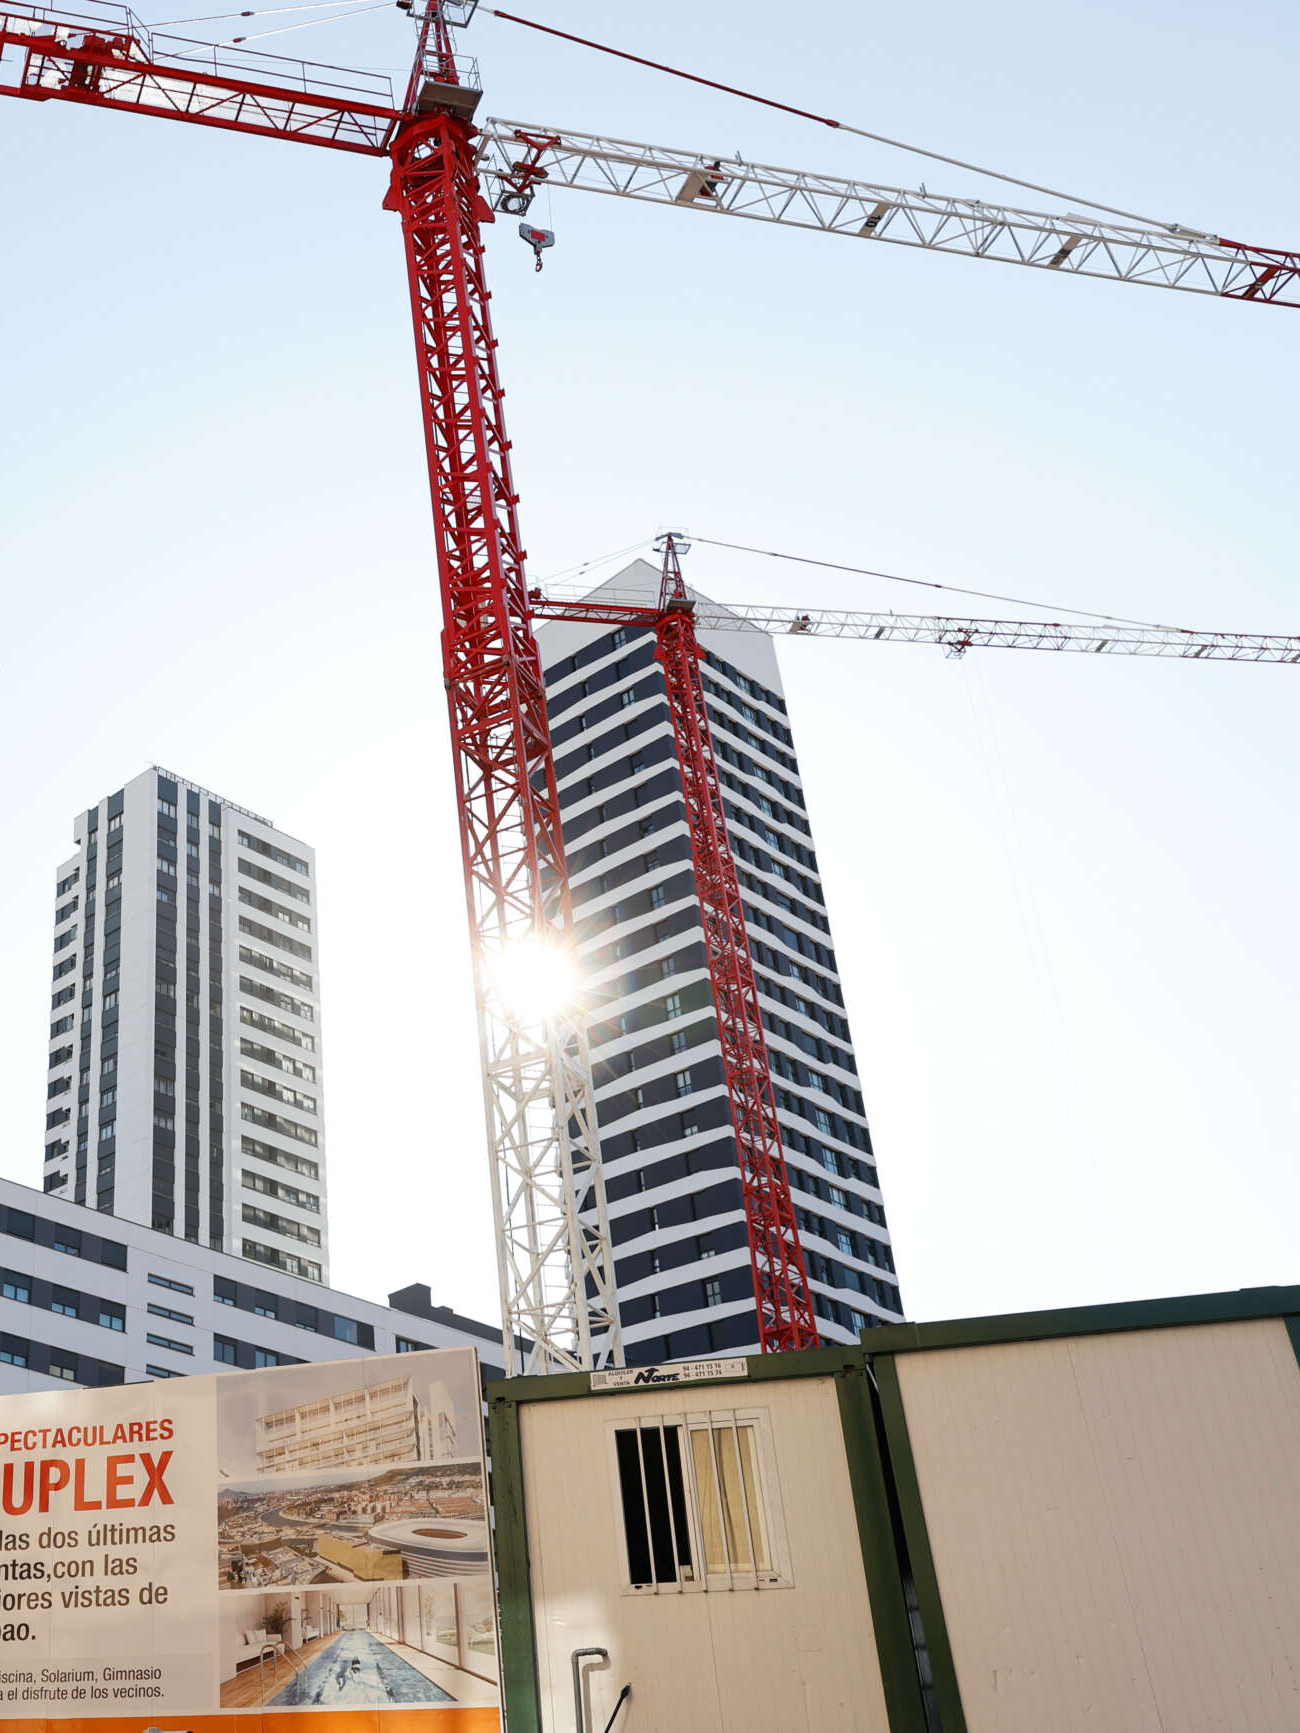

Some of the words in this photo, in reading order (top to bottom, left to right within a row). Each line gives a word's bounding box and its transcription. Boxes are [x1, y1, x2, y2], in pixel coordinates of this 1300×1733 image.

[38, 1527, 79, 1549] dos
[87, 1523, 176, 1547] últimas
[104, 1554, 138, 1576] las
[60, 1585, 130, 1608] vistas
[138, 1582, 168, 1605] de
[41, 1668, 98, 1684] Solarium,
[102, 1666, 162, 1682] Gimnasio
[7, 1687, 18, 1700] el
[22, 1686, 68, 1700] disfrute
[71, 1686, 86, 1699] de
[91, 1685, 108, 1698] los
[112, 1684, 164, 1698] vecinos.
